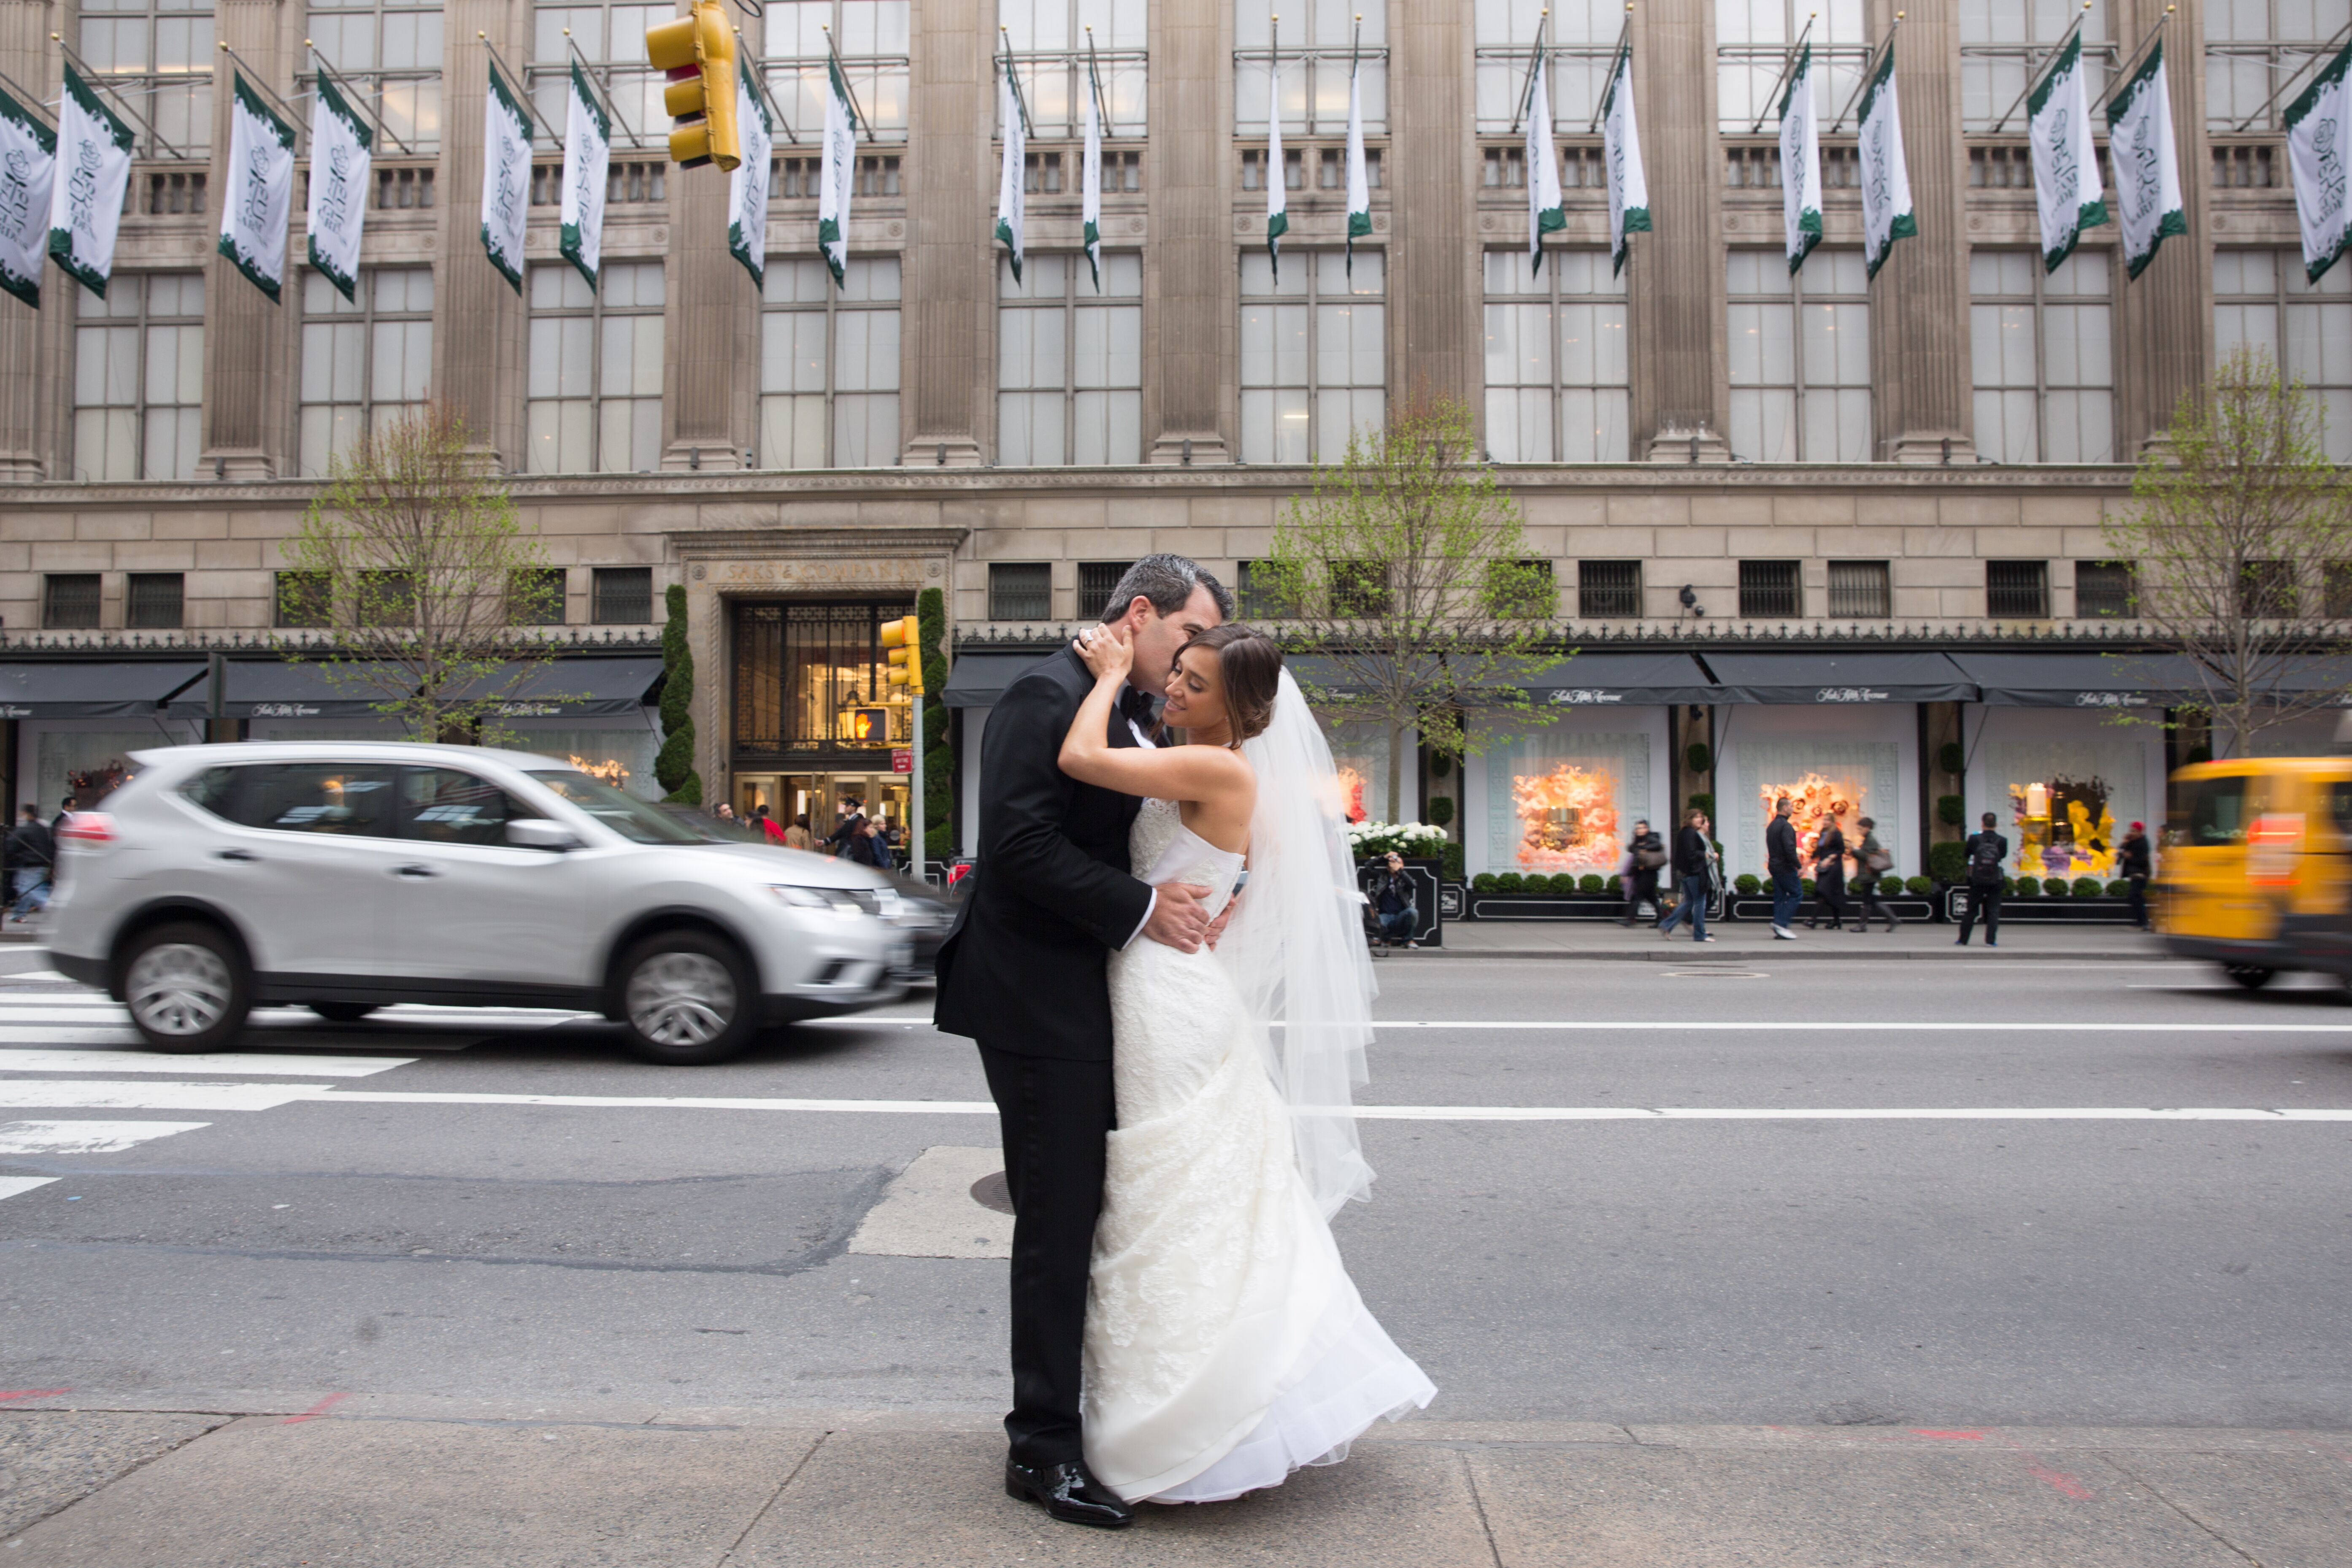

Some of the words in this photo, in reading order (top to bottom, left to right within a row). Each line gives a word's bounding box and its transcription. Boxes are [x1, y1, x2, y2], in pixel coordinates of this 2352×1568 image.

[728, 565, 775, 579] SAKS
[782, 565, 792, 579] &
[802, 564, 911, 579] COMPANY
